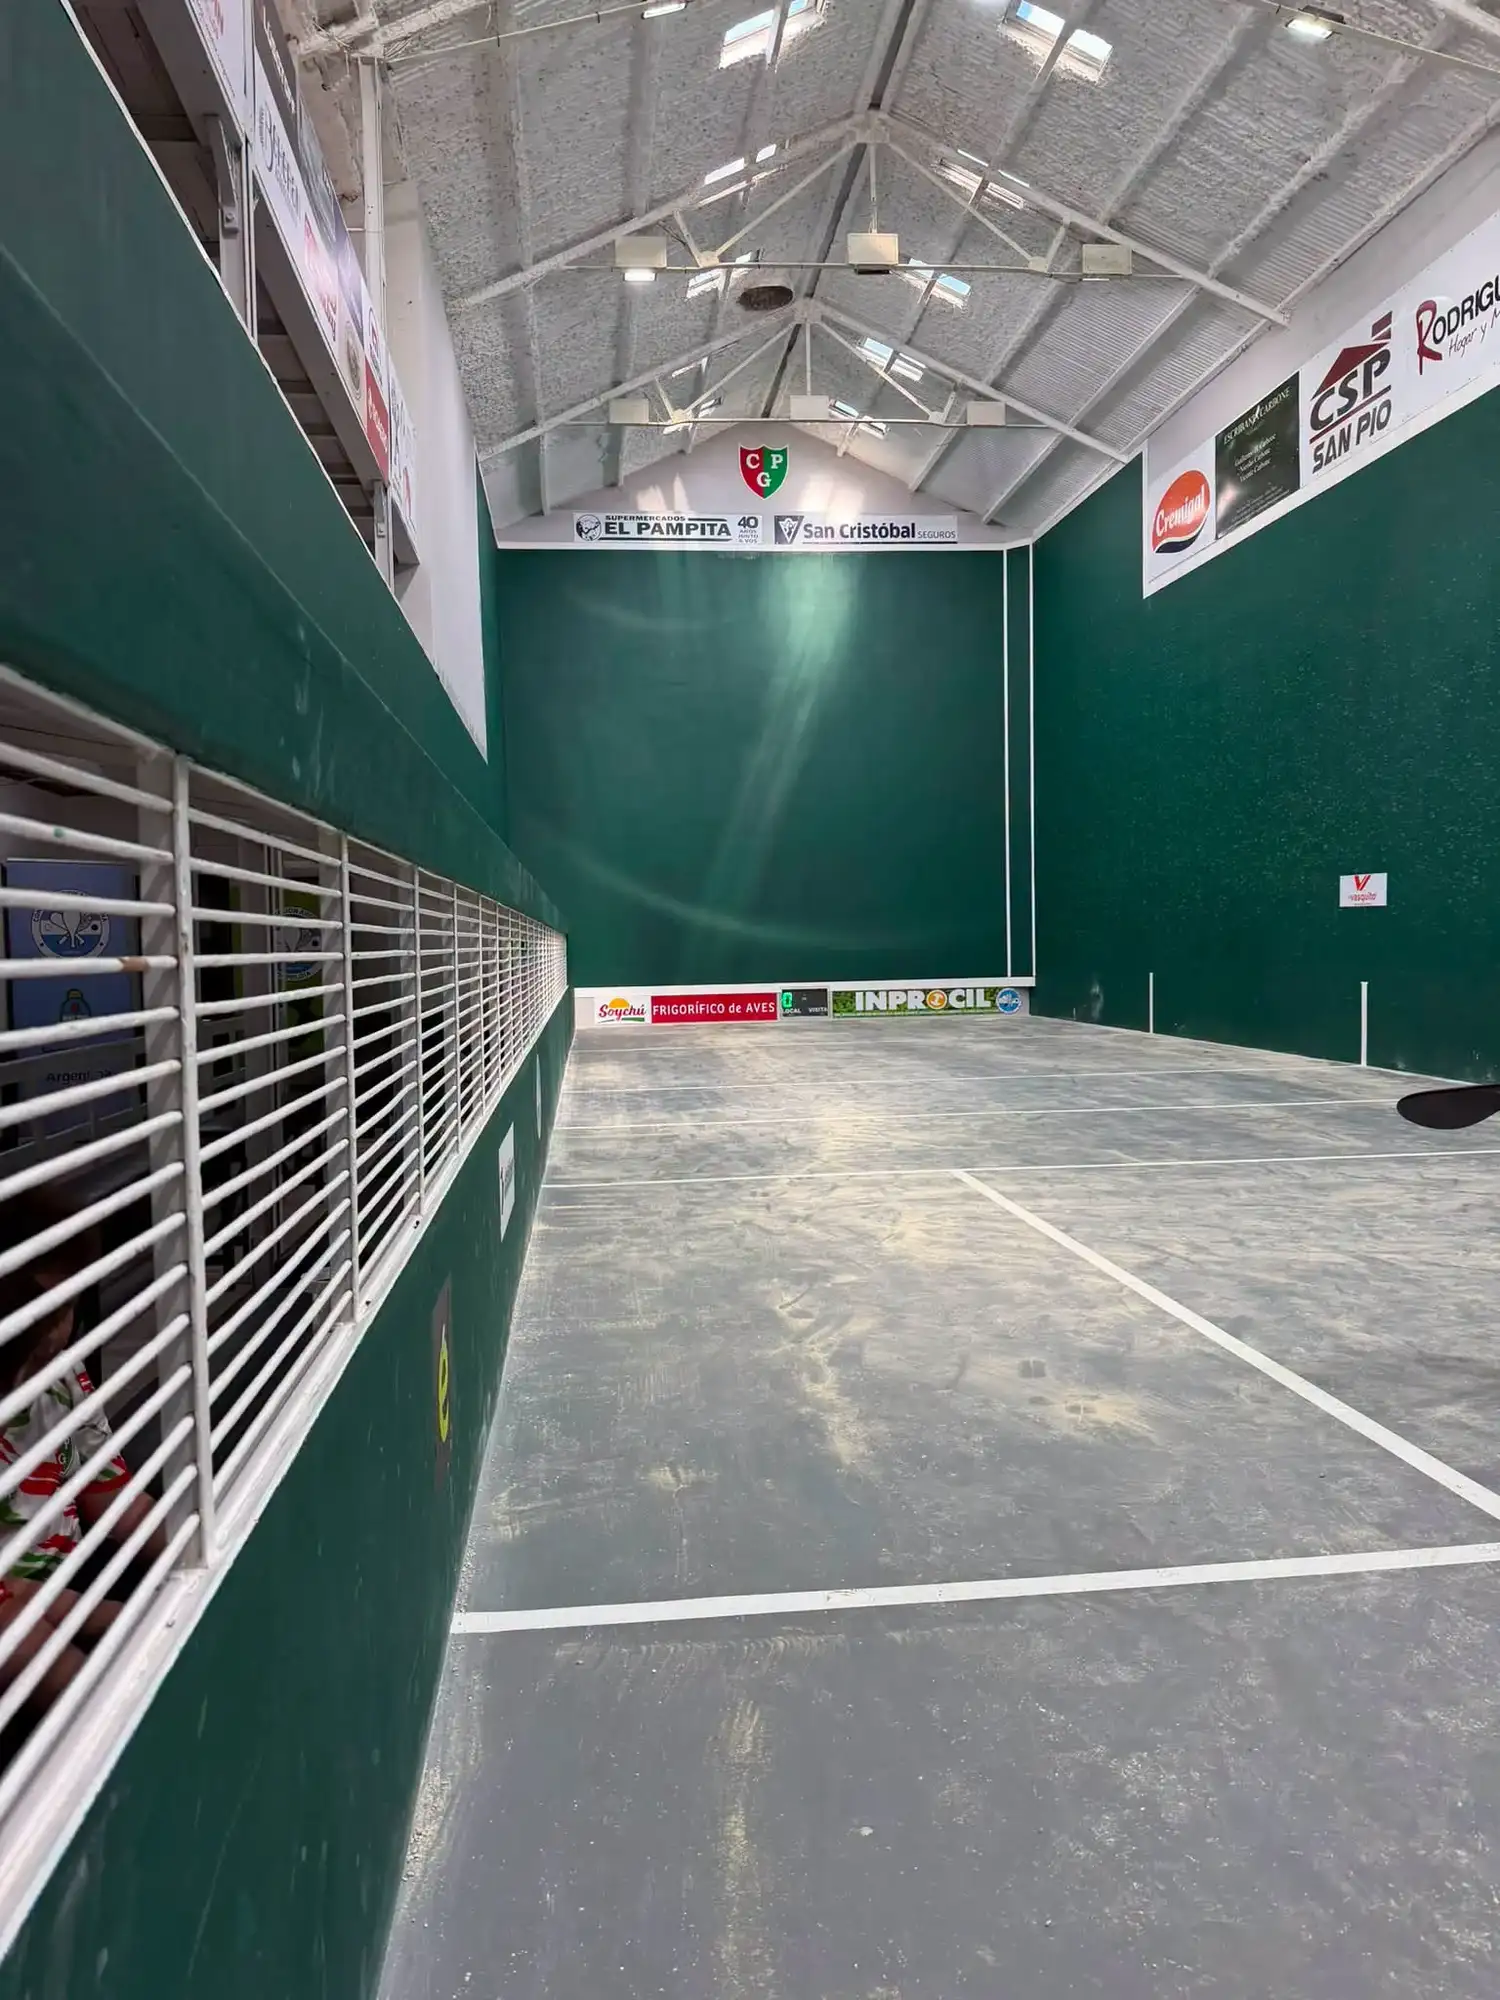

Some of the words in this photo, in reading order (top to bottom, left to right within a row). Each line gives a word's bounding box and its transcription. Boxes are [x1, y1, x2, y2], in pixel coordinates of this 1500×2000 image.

[1448, 326, 1478, 358] Hogar
[1310, 348, 1391, 431] CSP
[1312, 423, 1352, 474] SAN
[1356, 398, 1392, 446] PIO
[746, 453, 760, 469] C
[770, 453, 784, 469] P
[756, 471, 772, 488] G
[604, 522, 630, 535] EL
[636, 522, 732, 536] PAMPITA
[737, 516, 759, 528] 40
[803, 523, 835, 539] San
[839, 522, 916, 539] Cristóbal
[917, 530, 957, 539] SEGUROS
[782, 992, 793, 1008] 0
[598, 1004, 647, 1020] Soychú
[652, 1001, 725, 1016] FRIGORÍFICO
[728, 1003, 742, 1014] de
[745, 1002, 776, 1013] AVES
